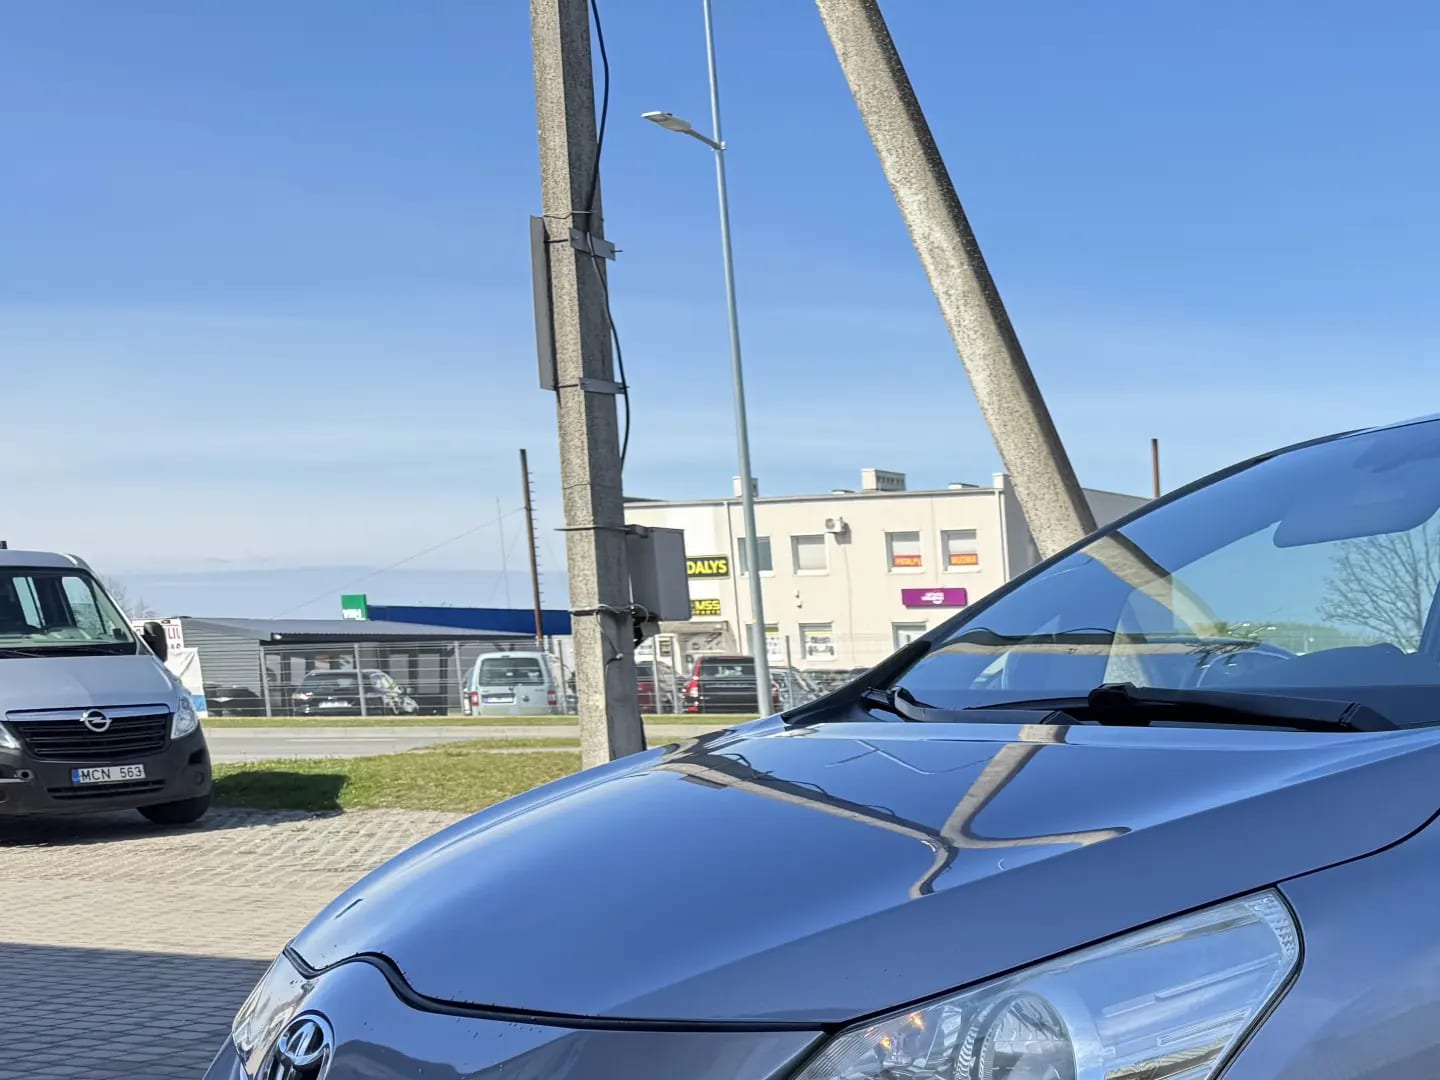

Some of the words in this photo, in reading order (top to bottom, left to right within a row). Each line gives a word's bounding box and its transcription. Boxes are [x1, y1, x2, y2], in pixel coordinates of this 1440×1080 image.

[687, 560, 727, 575] DALYS
[80, 768, 111, 781] MCN
[120, 766, 142, 778] 563
